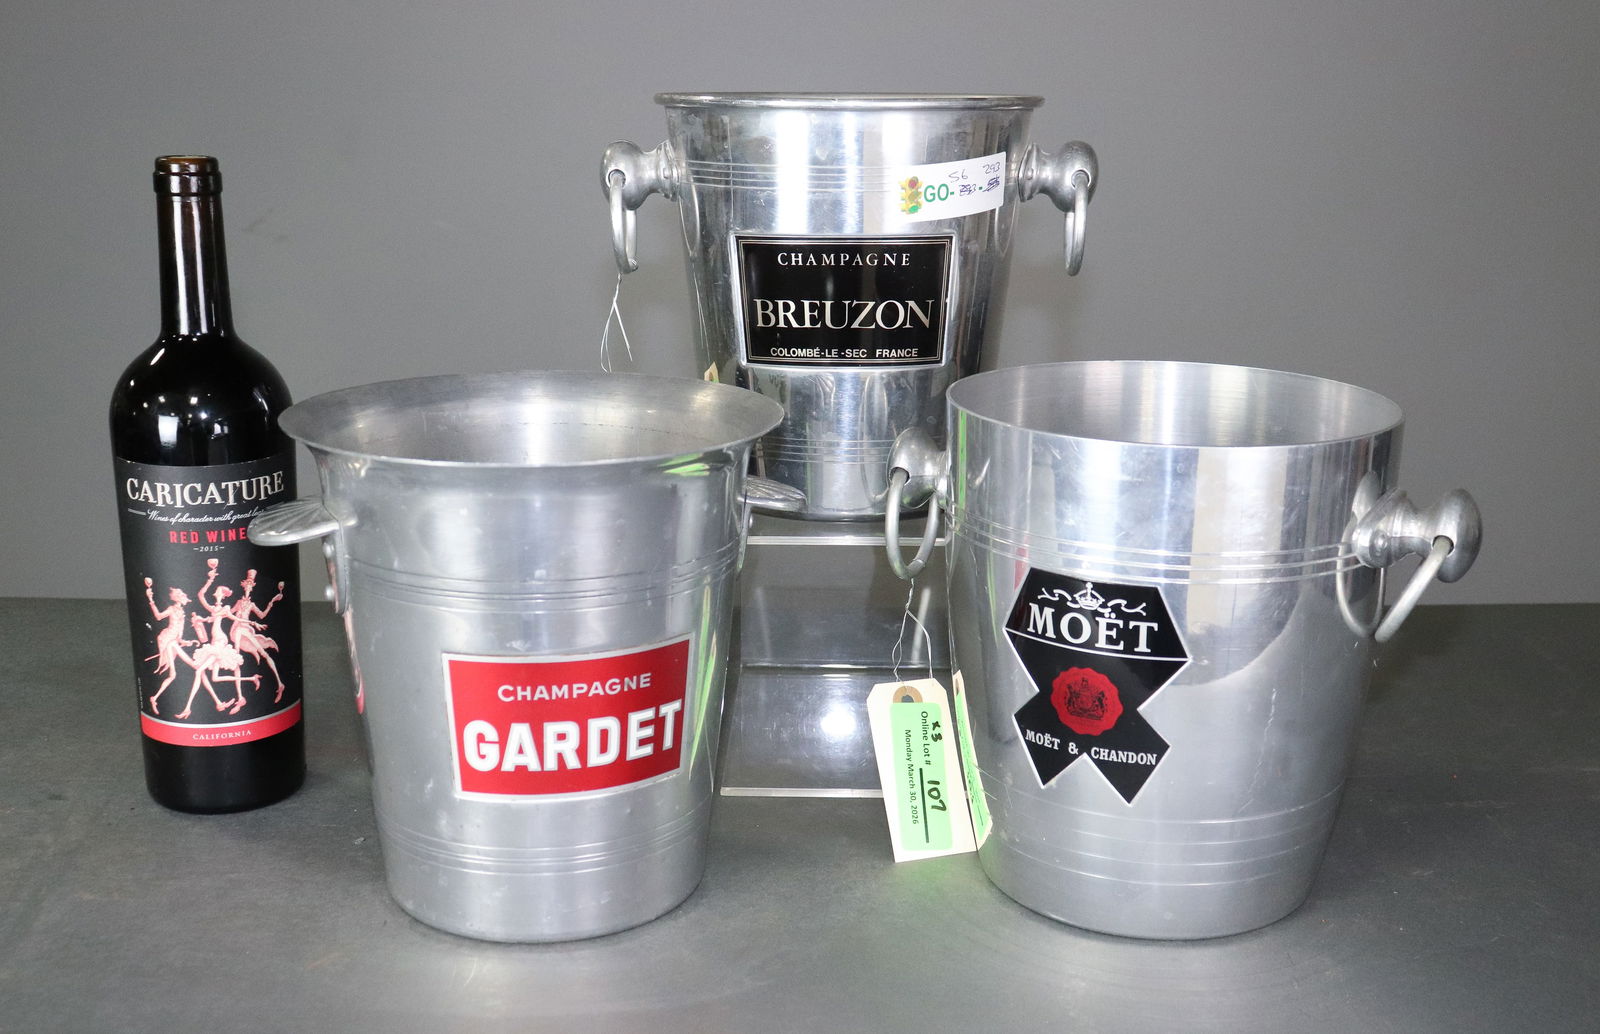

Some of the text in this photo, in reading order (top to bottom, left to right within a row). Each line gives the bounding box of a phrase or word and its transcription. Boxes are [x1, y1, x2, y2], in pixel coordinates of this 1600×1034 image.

[777, 252, 911, 267] CHAMPAGNE
[752, 298, 935, 330] BREUZON
[875, 348, 919, 358] FRANCE
[126, 470, 285, 509] CARICATURE
[147, 508, 169, 522] Wines
[169, 512, 182, 525] of
[178, 512, 216, 523] character
[214, 510, 233, 523] with
[231, 507, 253, 525] great
[169, 527, 247, 544] RED WINE
[1026, 601, 1159, 653] MOËT
[497, 672, 652, 702] CHAMPAGNE
[192, 730, 252, 740] CALIFORNIA
[463, 698, 683, 772] GARDET
[920, 710, 929, 741] Online
[923, 743, 932, 759] Lot
[1025, 729, 1158, 766] MOËT & CHANDON
[904, 729, 920, 825] Monday March 30, 2026
[927, 780, 947, 812] 107
